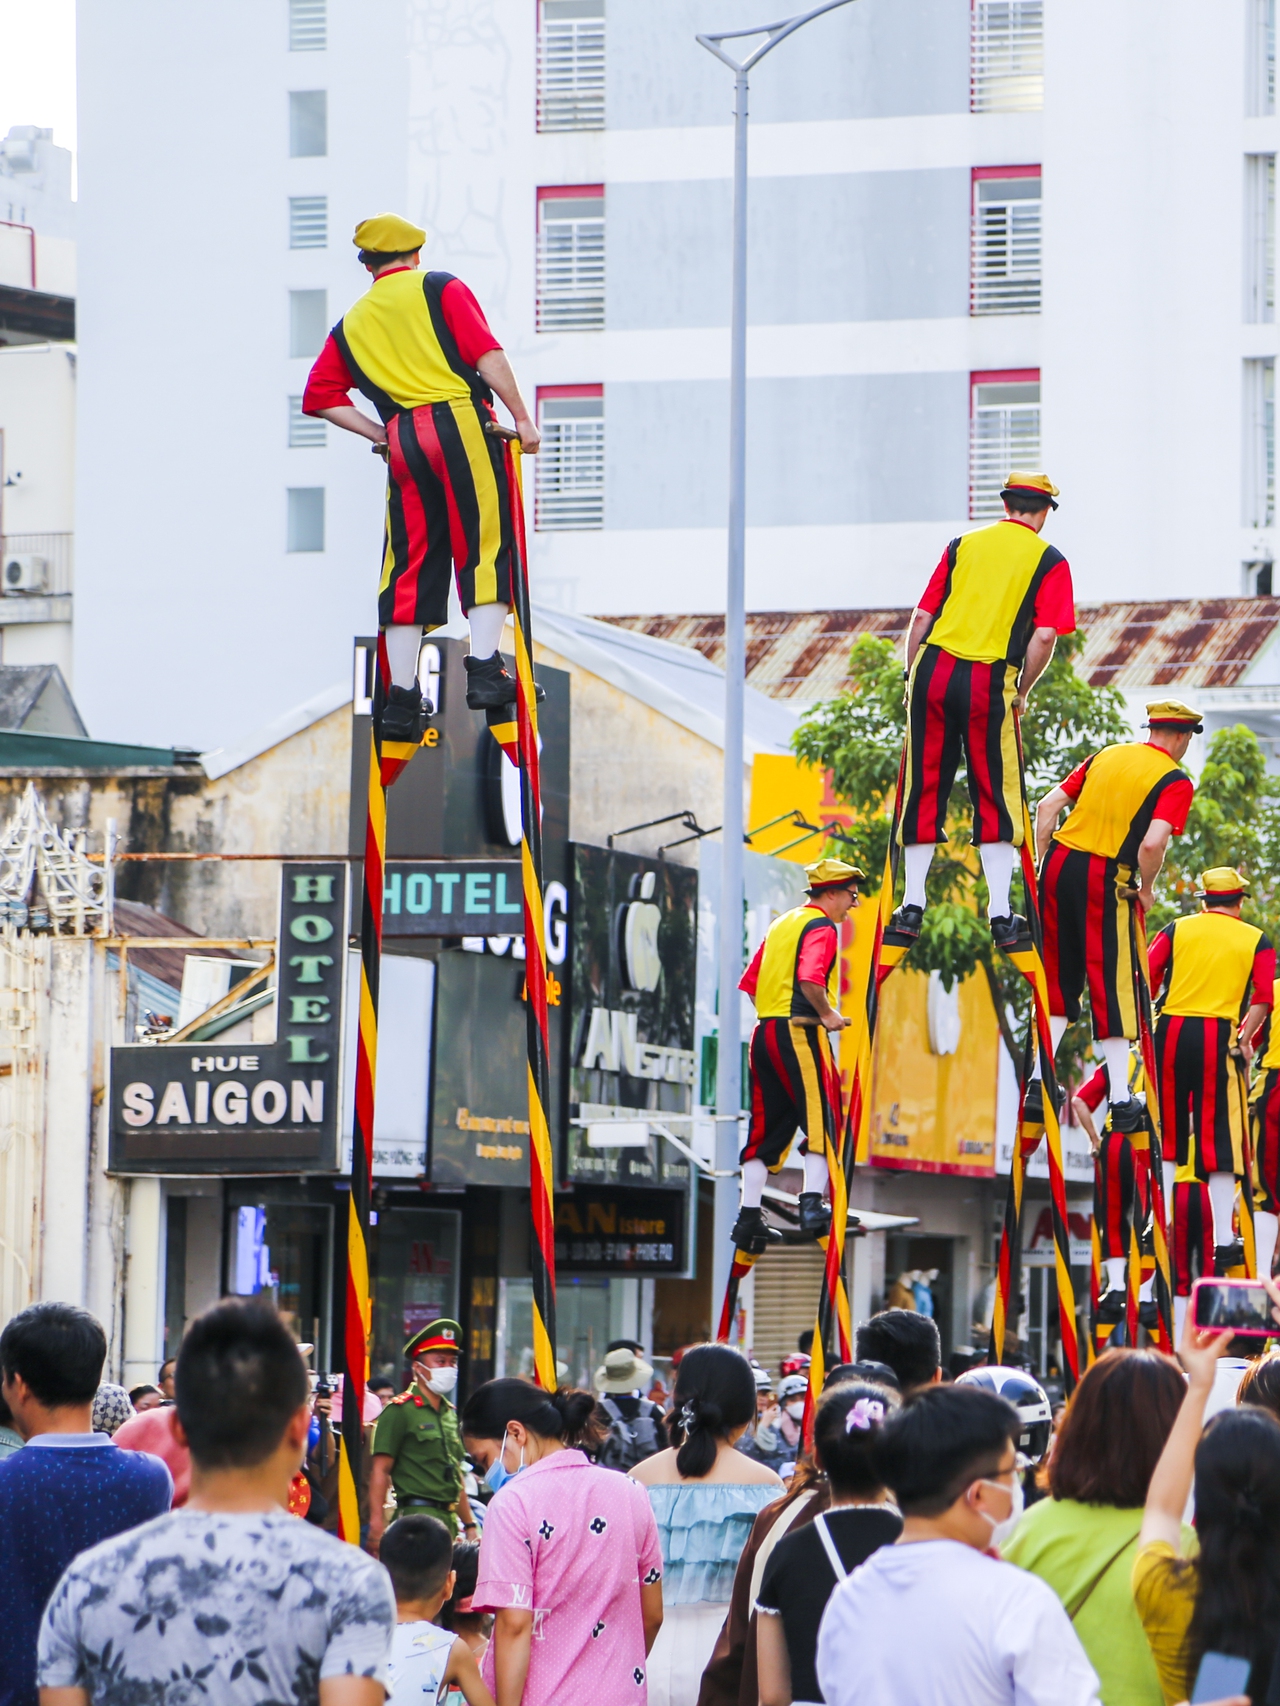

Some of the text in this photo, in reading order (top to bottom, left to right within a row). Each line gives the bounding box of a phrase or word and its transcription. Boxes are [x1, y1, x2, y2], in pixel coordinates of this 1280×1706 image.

[383, 873, 521, 914] HOTEL
[286, 874, 335, 1063] HOTEL
[191, 1056, 259, 1072] HUE
[122, 1080, 324, 1126] SAIGON
